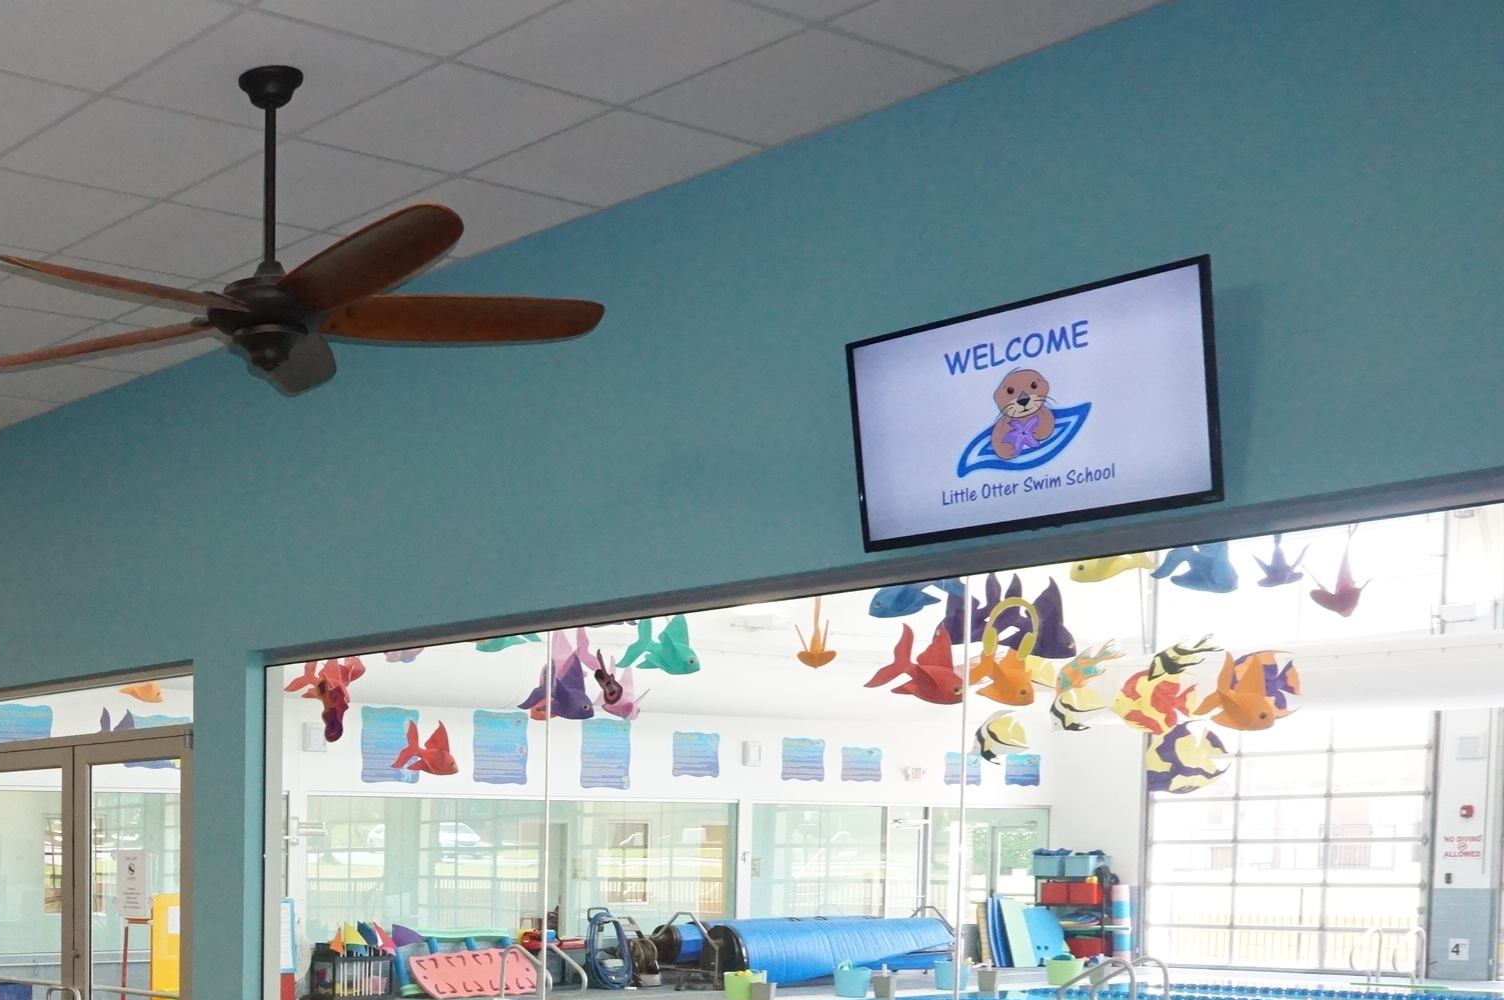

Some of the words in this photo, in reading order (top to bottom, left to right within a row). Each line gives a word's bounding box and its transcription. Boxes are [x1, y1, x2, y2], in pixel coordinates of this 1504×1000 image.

[944, 320, 1089, 375] WELCOME
[942, 487, 977, 506] Little
[981, 483, 1019, 499] Otter
[1023, 475, 1062, 493] Swim
[1066, 463, 1116, 486] School
